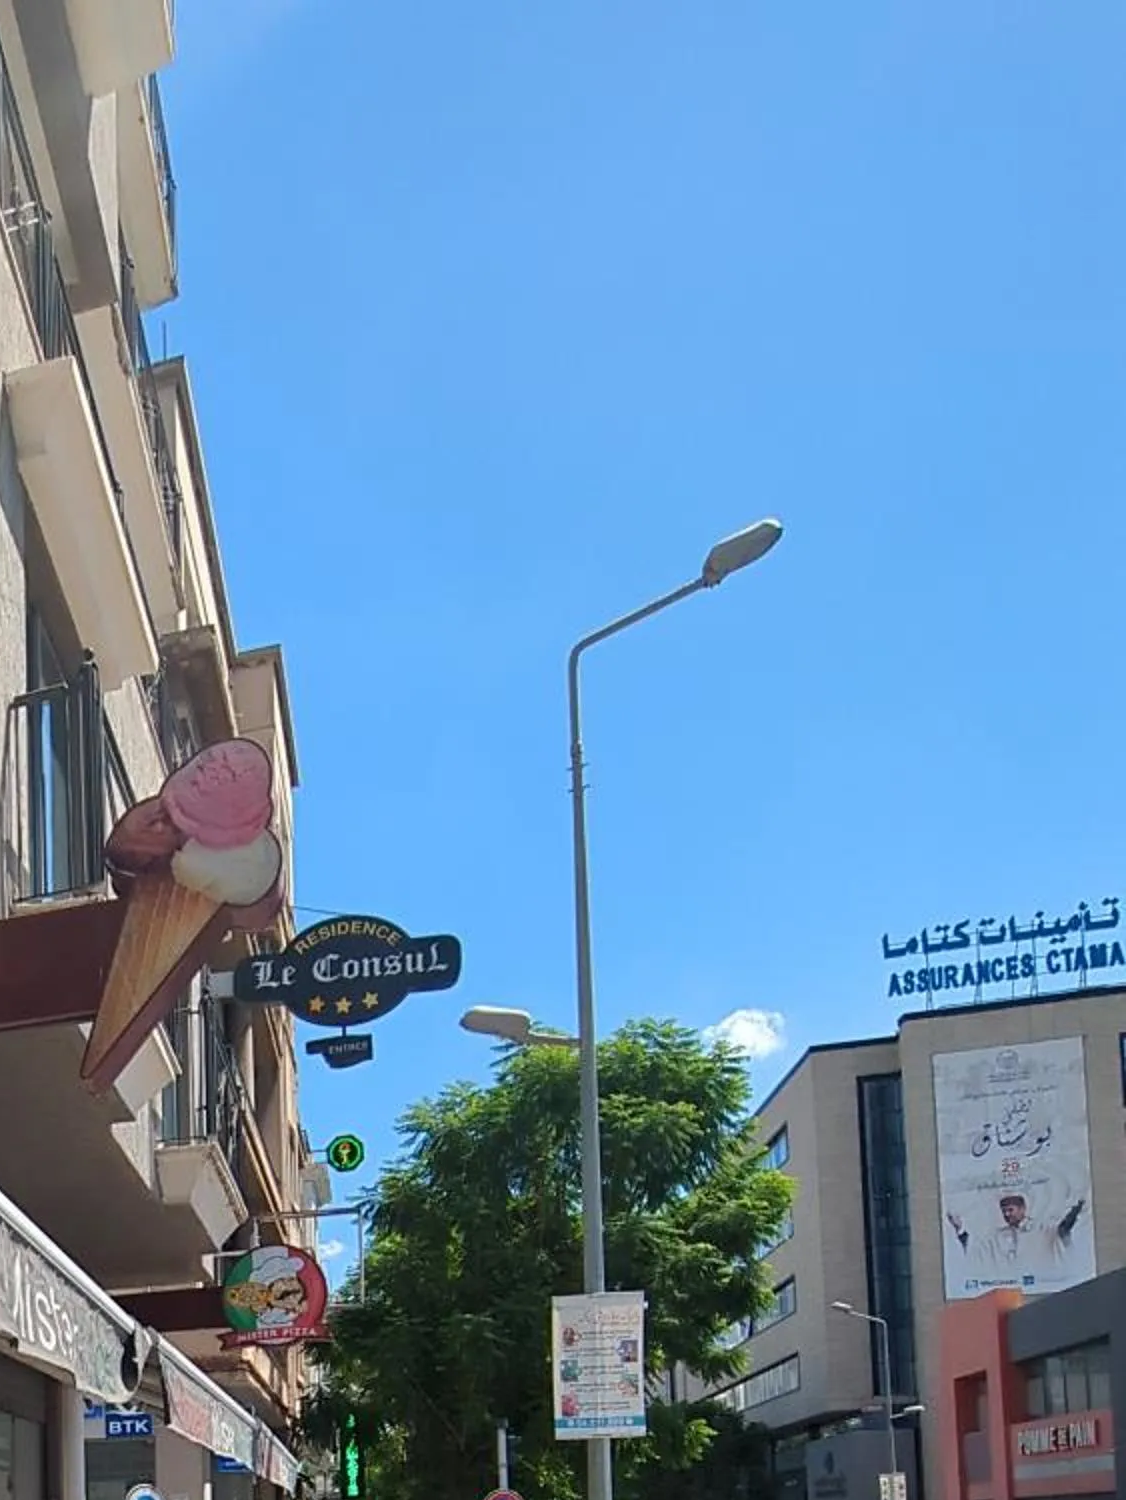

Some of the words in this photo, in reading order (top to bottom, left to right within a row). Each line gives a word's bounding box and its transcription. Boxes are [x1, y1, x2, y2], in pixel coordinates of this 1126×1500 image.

[294, 920, 403, 955] RESIDENCE
[251, 959, 297, 990] Le
[887, 953, 1036, 998] ASSURANCES
[1045, 941, 1125, 974] CTAMA
[108, 1418, 150, 1435] BTK
